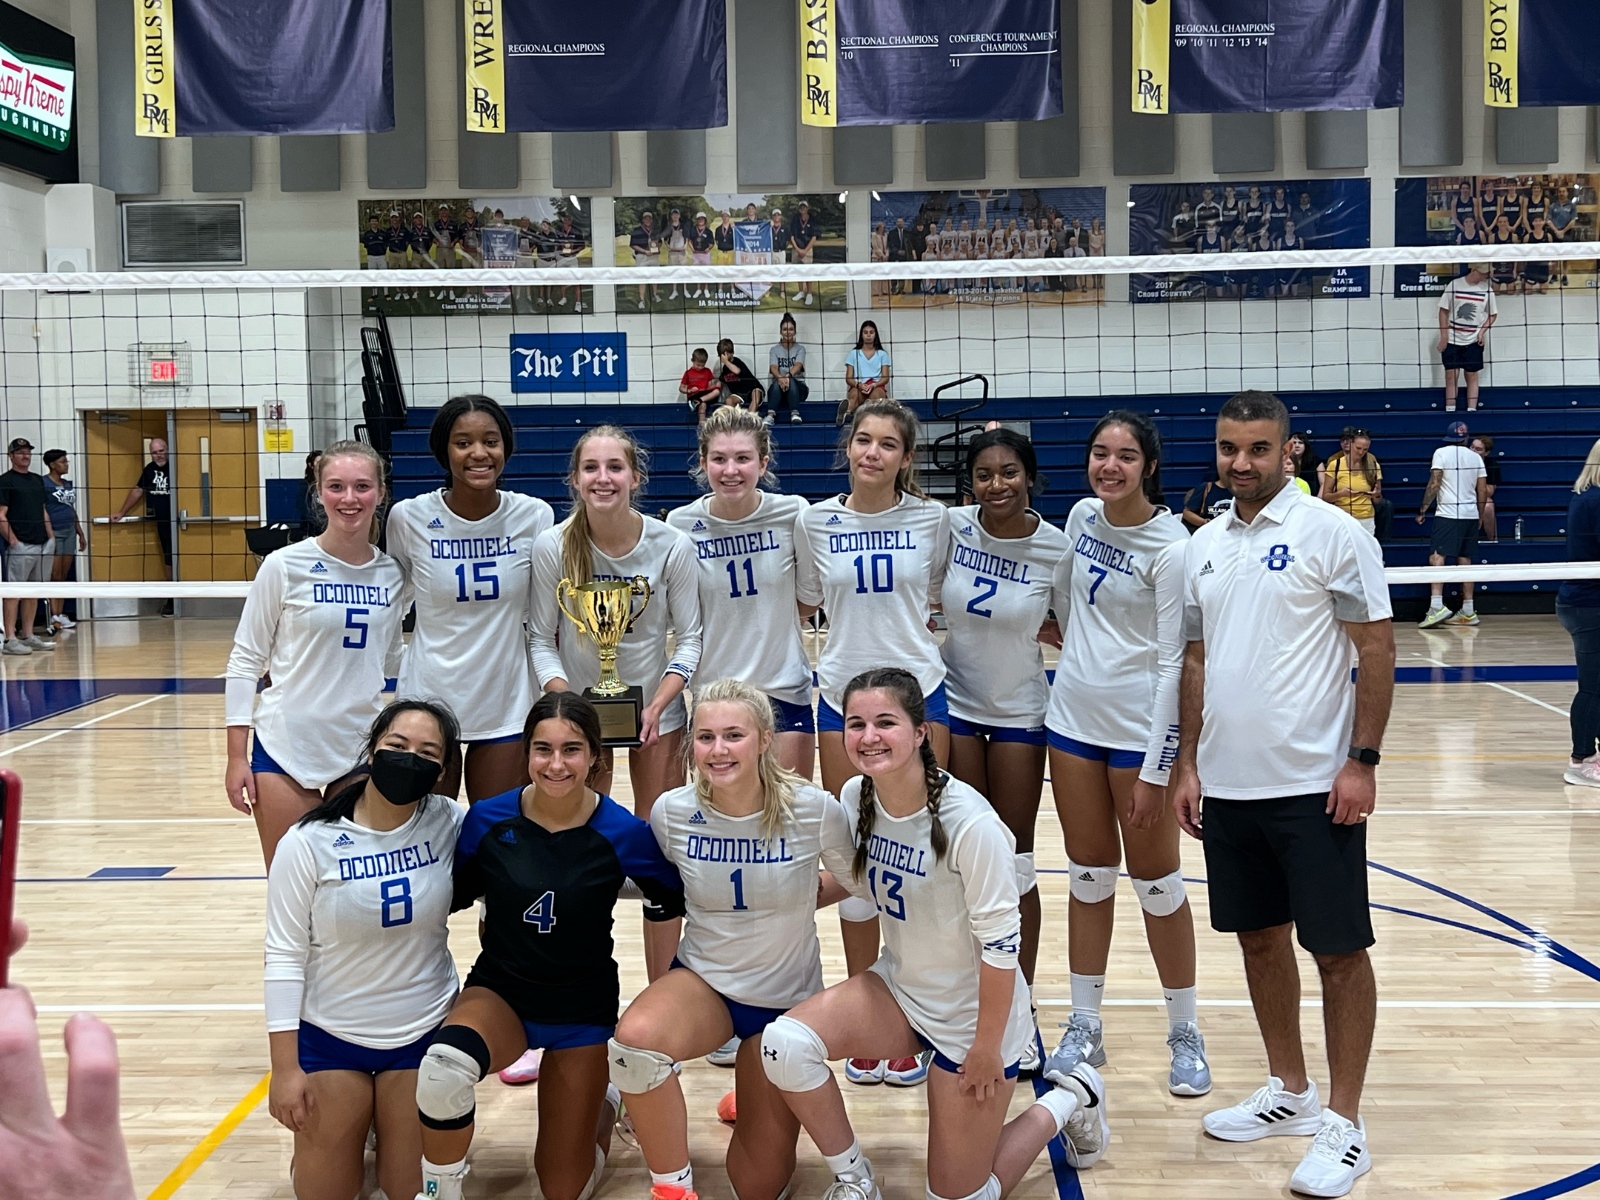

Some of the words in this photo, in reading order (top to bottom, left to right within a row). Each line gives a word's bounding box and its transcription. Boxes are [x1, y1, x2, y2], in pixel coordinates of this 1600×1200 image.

[840, 36, 887, 46] SECTIONAL
[888, 35, 939, 45] CHAMPIONS
[949, 33, 1002, 43] CONFERENCE
[1003, 30, 1058, 42] TOURNAMENT
[1174, 24, 1220, 33] REGIONAL
[1221, 23, 1276, 33] CHAMPIONS
[1174, 38, 1187, 47] '09
[1190, 38, 1203, 47] '10
[1206, 38, 1218, 47] '11
[1222, 38, 1234, 47] '12
[1238, 38, 1251, 47] '13
[1255, 37, 1268, 46] '14
[144, 15, 165, 85] GIRLS
[508, 44, 552, 53] REGIONAL
[553, 43, 605, 52] CHAMPIONS
[841, 51, 854, 60] '10
[980, 43, 1028, 52] CHAMPIONS
[949, 58, 960, 67] '11
[1155, 281, 1174, 289] 2017
[1336, 268, 1347, 276] 1A
[1418, 275, 1439, 283] 2014
[1321, 285, 1362, 293] CHAMPONS
[151, 361, 175, 380] EXIT
[511, 347, 563, 378] The
[569, 346, 619, 377] Pit
[430, 536, 517, 559] OCONNELL
[696, 530, 780, 559] OCONNELL
[829, 530, 917, 553] OCONNELL
[1074, 532, 1135, 576] OCONNELL
[726, 557, 758, 598] 11
[853, 554, 894, 594] 10
[953, 544, 1031, 585] OCONNELL
[313, 583, 391, 607] OCONNELL
[455, 561, 500, 602] 15
[1088, 564, 1109, 606] 7
[966, 575, 999, 618] 2
[343, 608, 370, 649] 5
[339, 840, 440, 881] OCONNELL
[686, 835, 793, 863] OCONNELL
[855, 832, 926, 877] ONNELL
[380, 877, 413, 928] 8
[730, 868, 748, 910] 1
[868, 865, 907, 921] 13
[523, 890, 557, 933] 4
